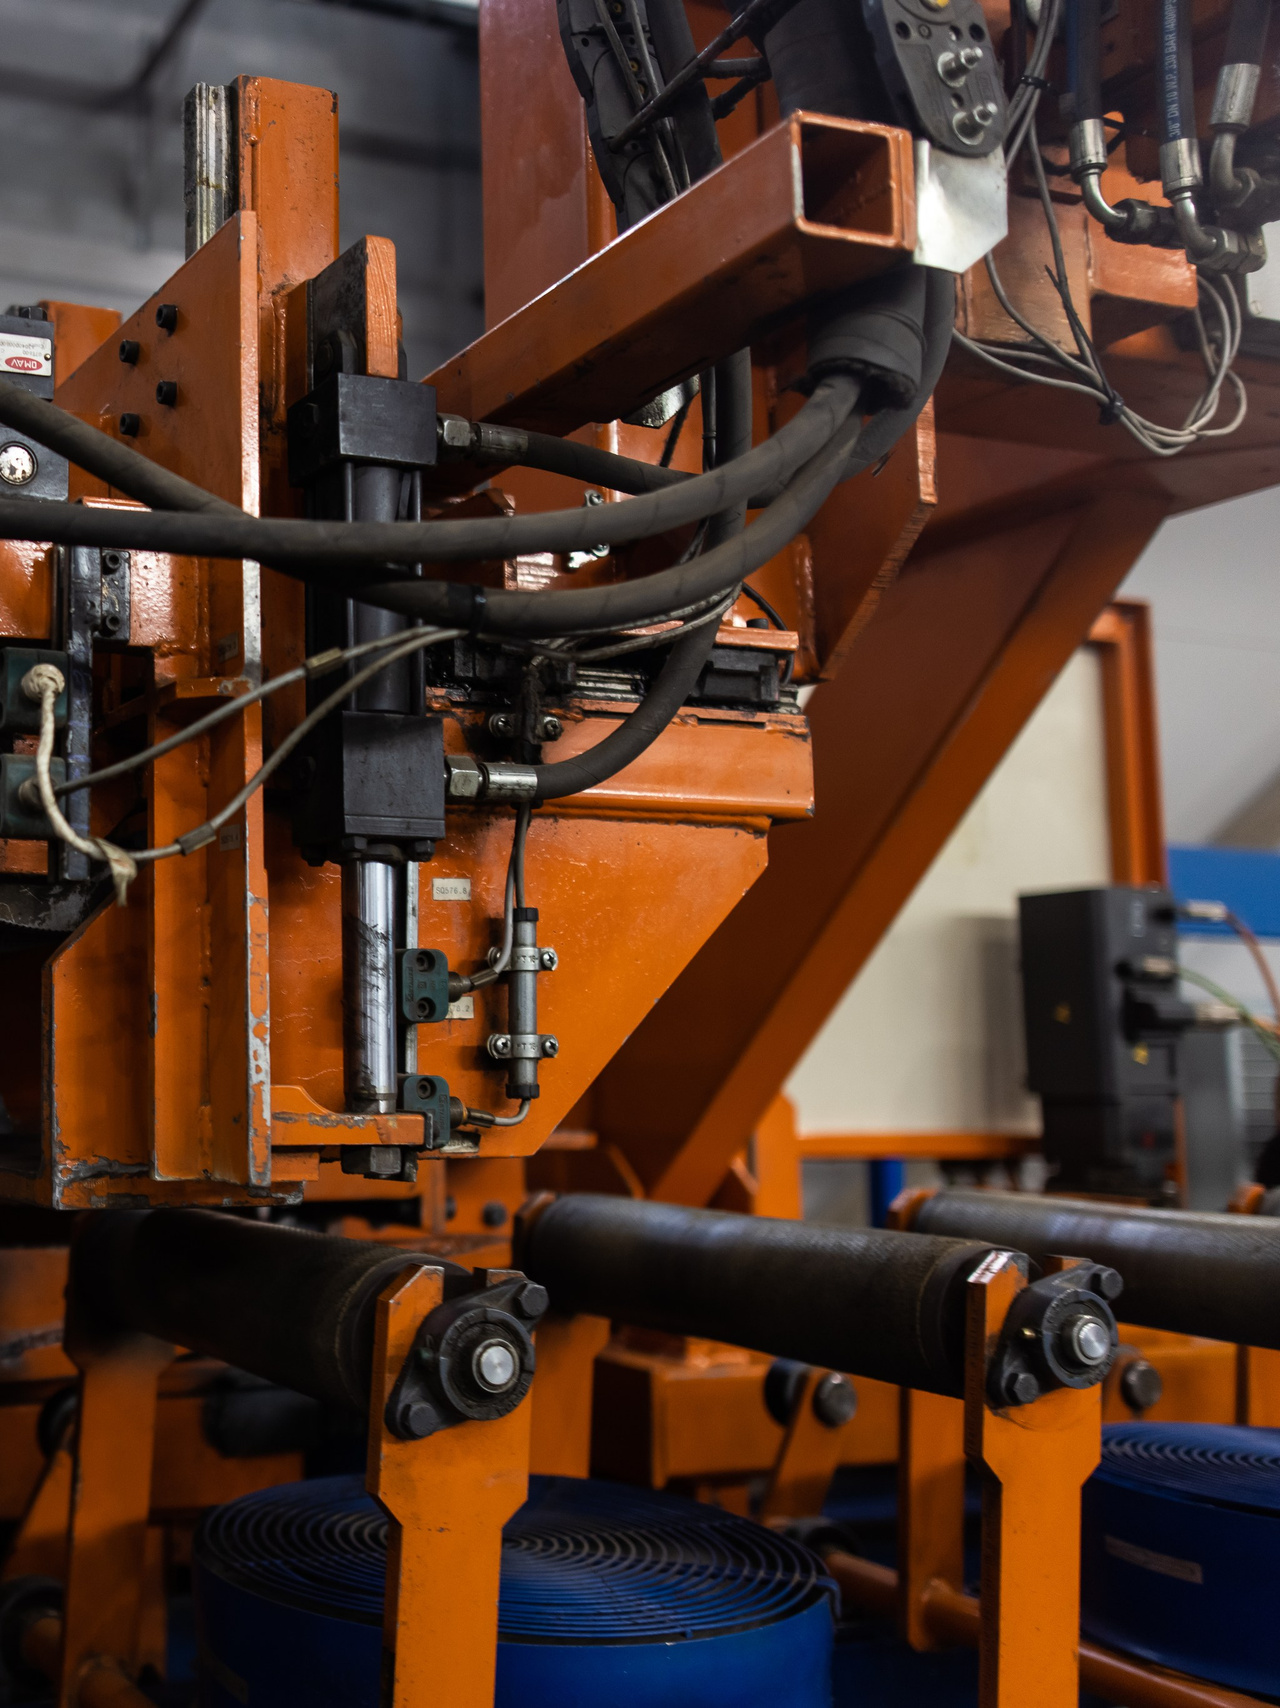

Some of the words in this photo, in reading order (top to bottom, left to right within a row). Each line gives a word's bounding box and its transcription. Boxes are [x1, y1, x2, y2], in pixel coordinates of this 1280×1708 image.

[1164, 33, 1177, 53] BAR
[1164, 54, 1177, 69] 330
[1164, 71, 1178, 91] W.P.
[1166, 91, 1179, 102] 10
[1167, 104, 1180, 118] DN
[1167, 121, 1181, 137] 3/8"
[10, 358, 38, 369] OMAV
